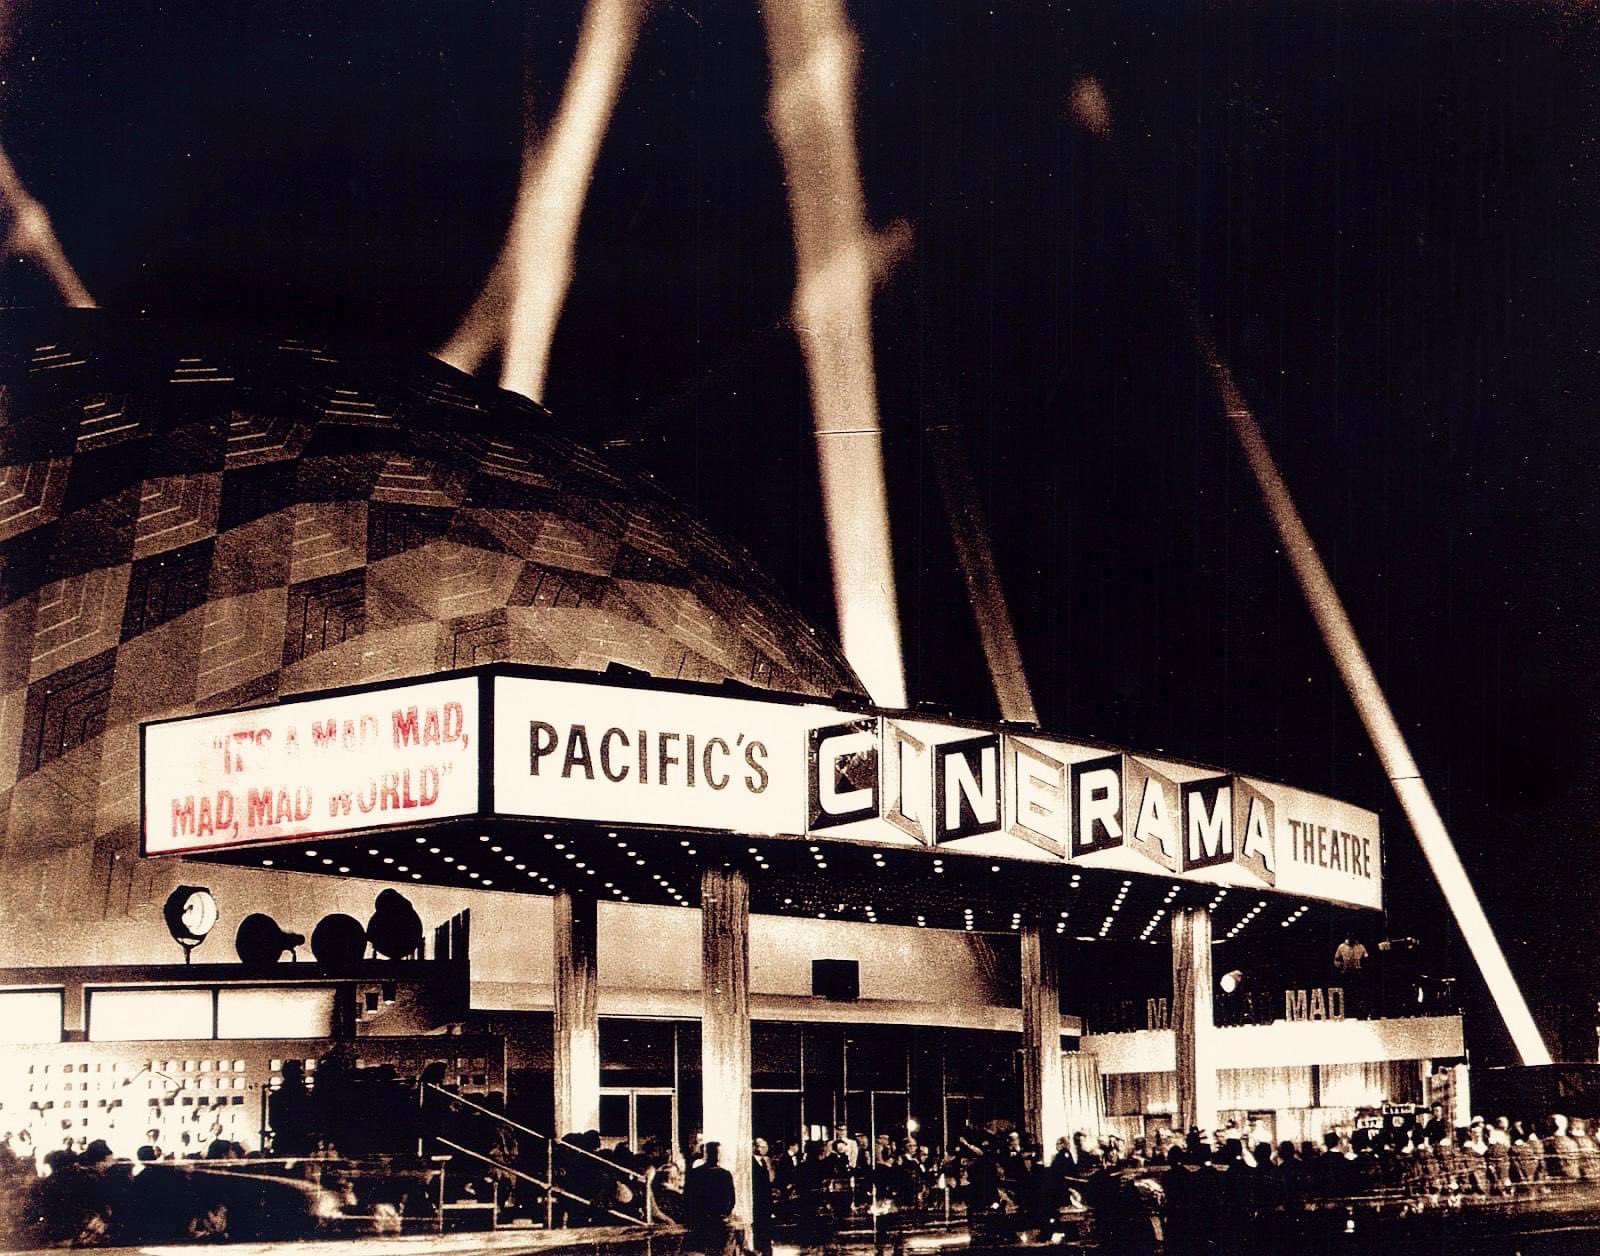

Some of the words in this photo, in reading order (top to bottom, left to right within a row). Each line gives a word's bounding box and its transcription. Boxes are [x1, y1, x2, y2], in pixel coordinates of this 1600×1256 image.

[391, 701, 468, 750] MAD,
[529, 719, 769, 794] PACIFIC'S
[171, 789, 239, 838] MAD,
[247, 785, 313, 828] MAD
[817, 729, 1273, 873] CINERAMA
[1288, 818, 1371, 879] THEATRE
[1285, 987, 1344, 1022] MAD
